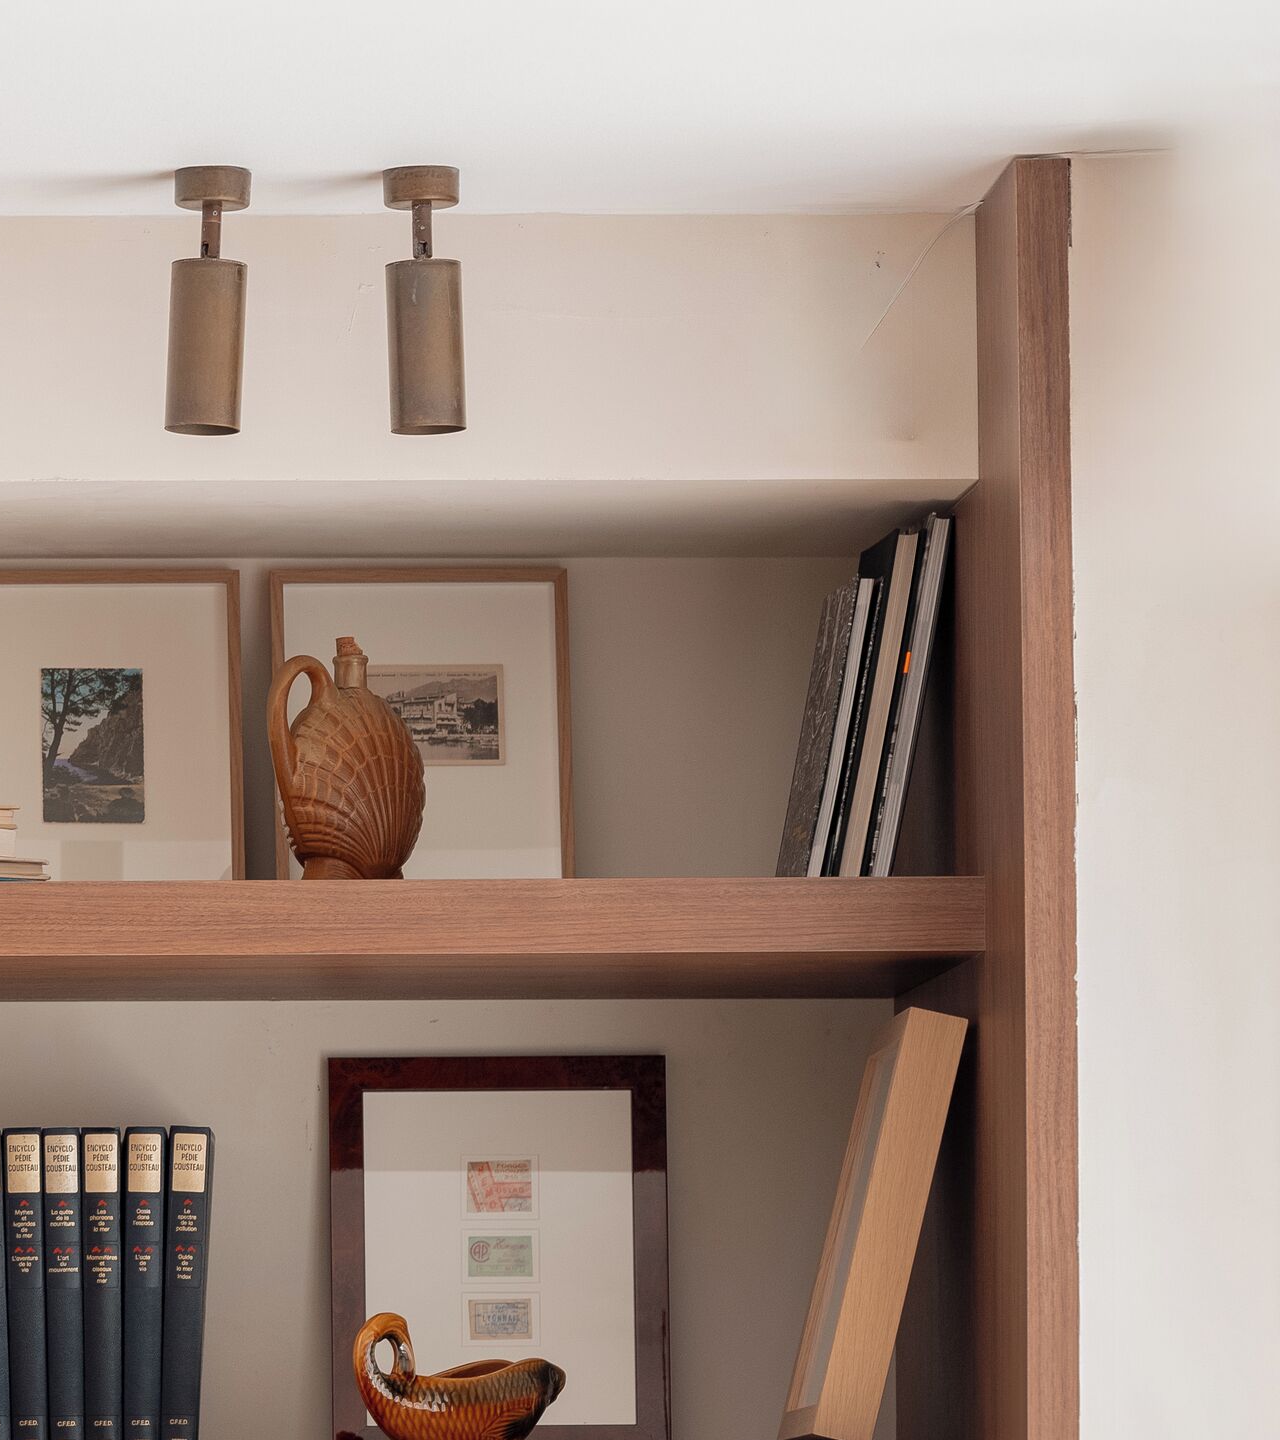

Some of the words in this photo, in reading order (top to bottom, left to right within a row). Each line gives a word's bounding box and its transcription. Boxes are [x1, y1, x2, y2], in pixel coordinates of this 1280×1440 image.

[15, 1154, 31, 1162] PÉDIE
[53, 1154, 70, 1162] PÉDIE
[93, 1153, 109, 1161] PÉDIE
[136, 1153, 153, 1161] PÉDIE
[181, 1153, 198, 1161] PÉDIE
[8, 1164, 38, 1172] COUSTEAU
[47, 1165, 76, 1173] COUSTEAU
[86, 1164, 116, 1172] COUSTEAU
[129, 1164, 159, 1172] COUSTEAU
[174, 1163, 204, 1171] COUSTEAU
